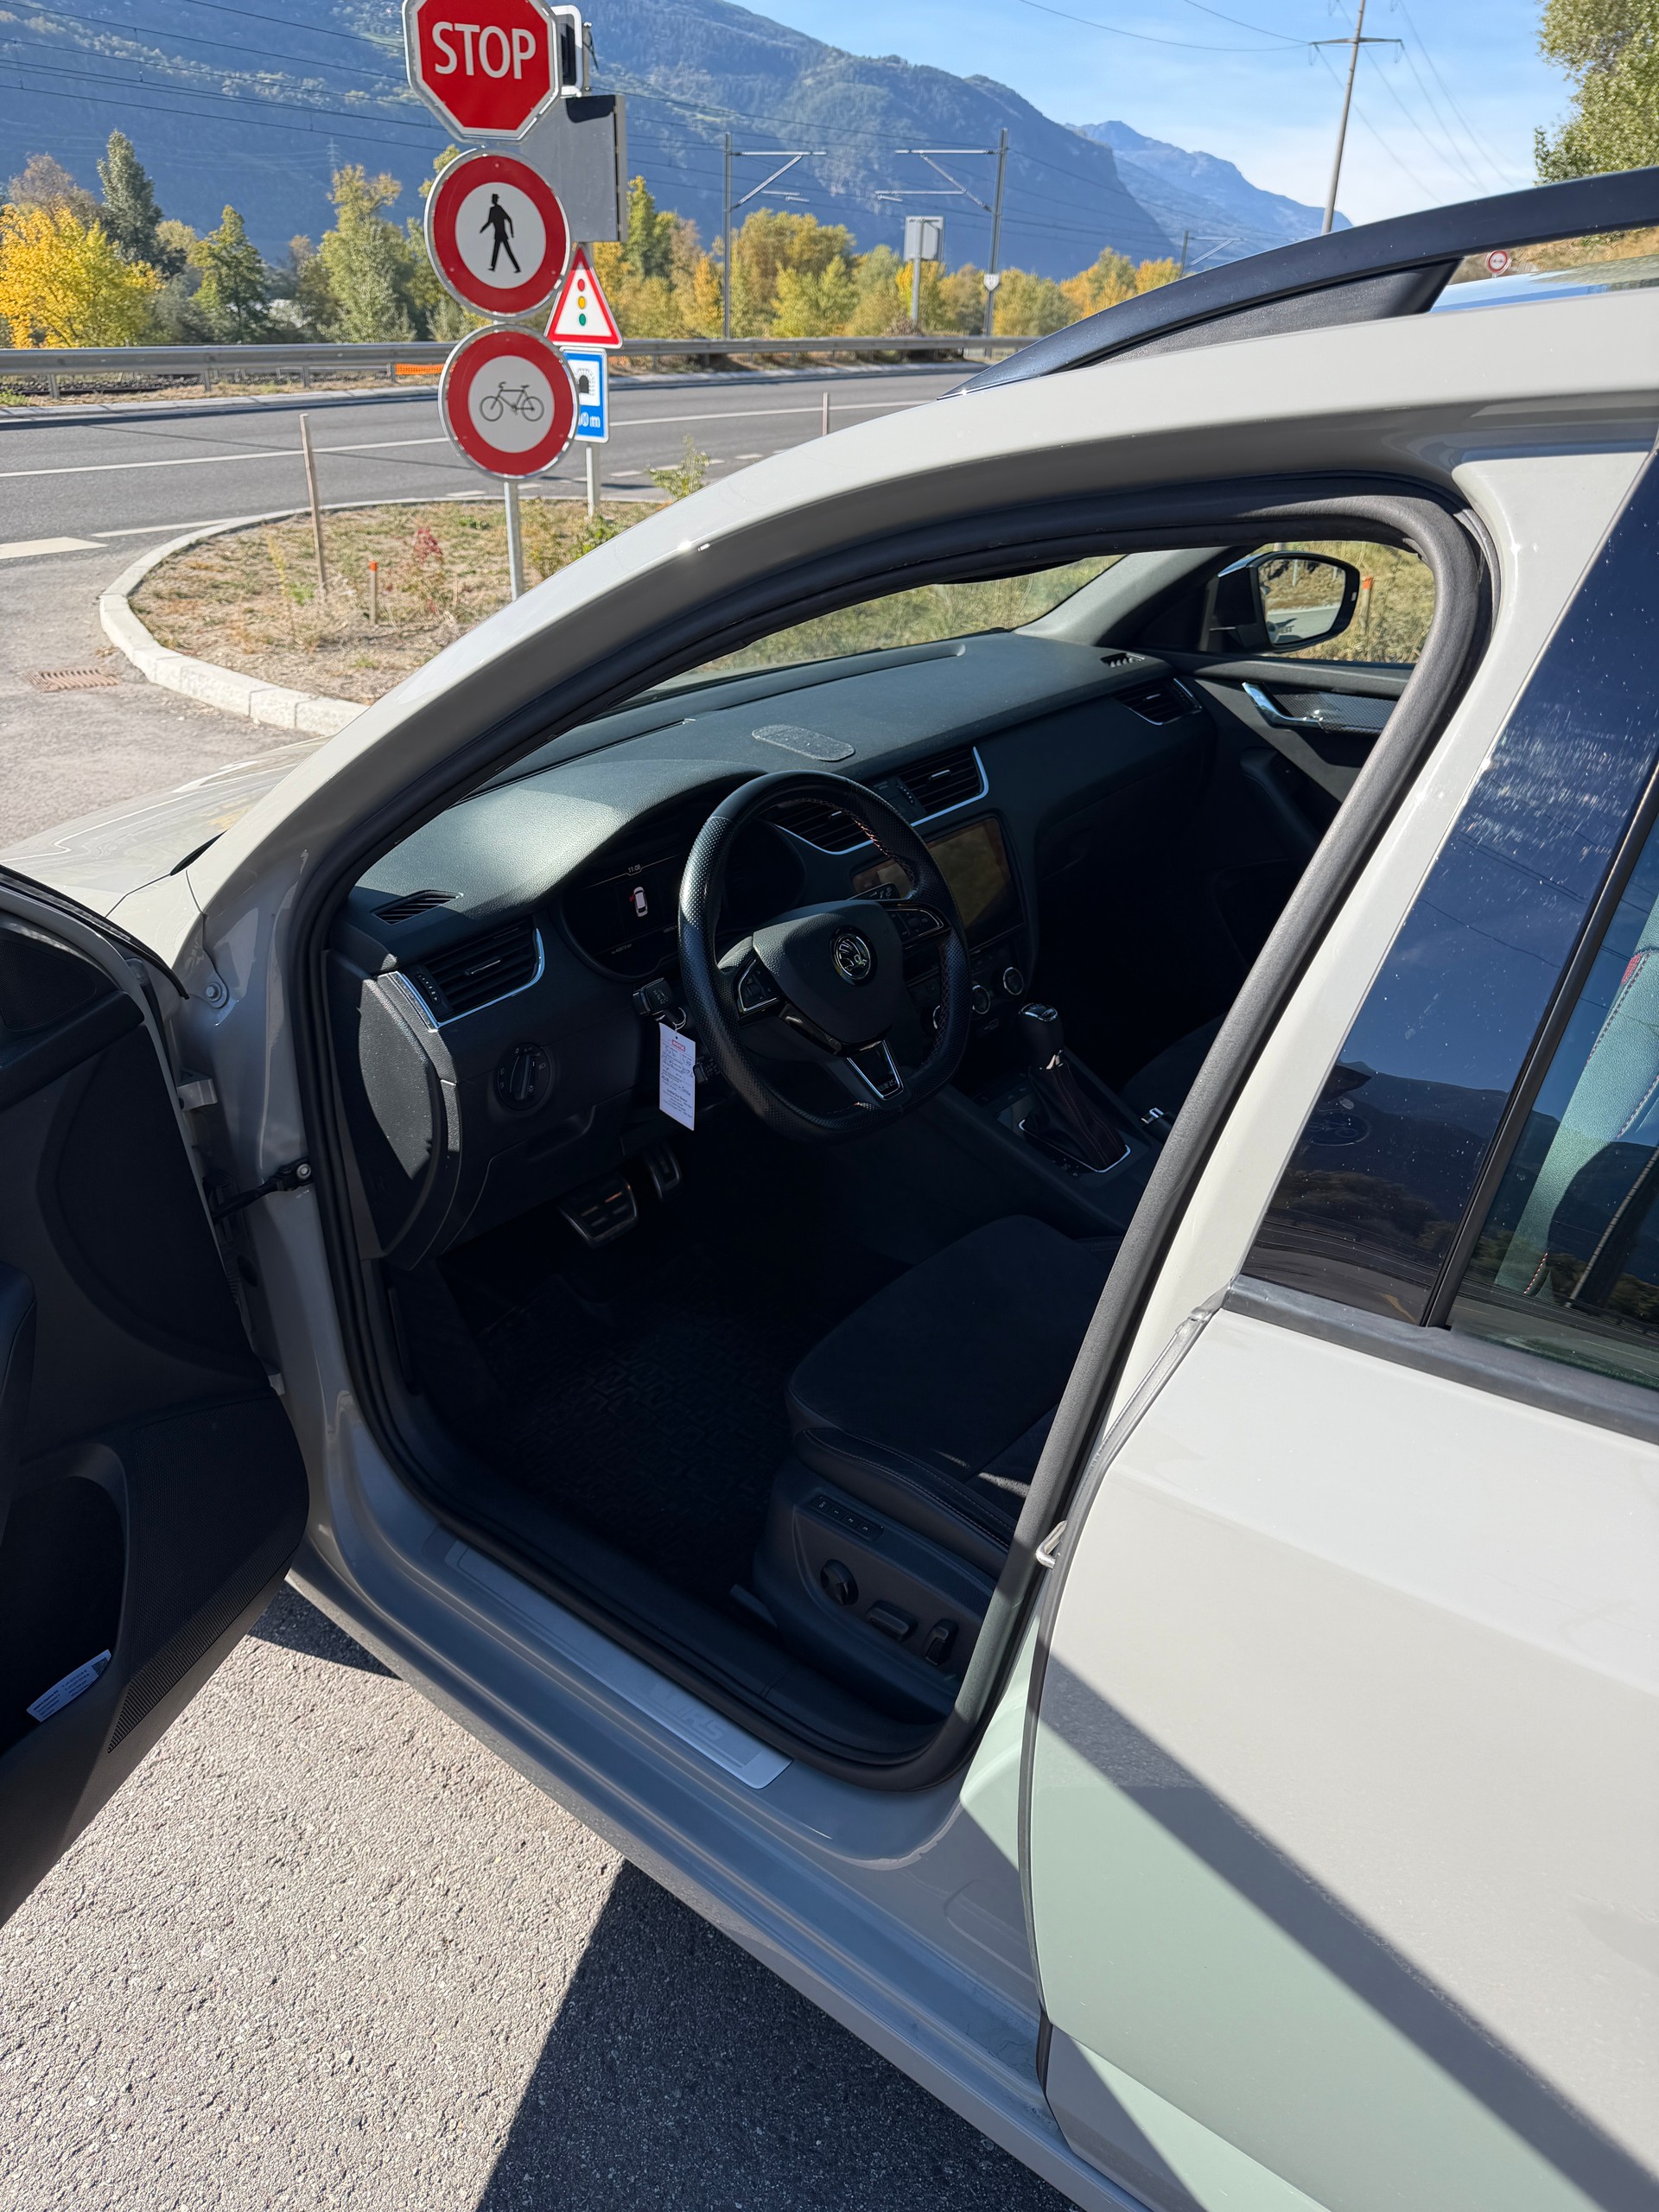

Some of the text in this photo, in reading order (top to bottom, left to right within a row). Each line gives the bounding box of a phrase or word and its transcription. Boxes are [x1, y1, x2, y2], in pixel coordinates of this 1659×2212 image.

[432, 22, 536, 79] STOP
[578, 411, 601, 429] 0 m
